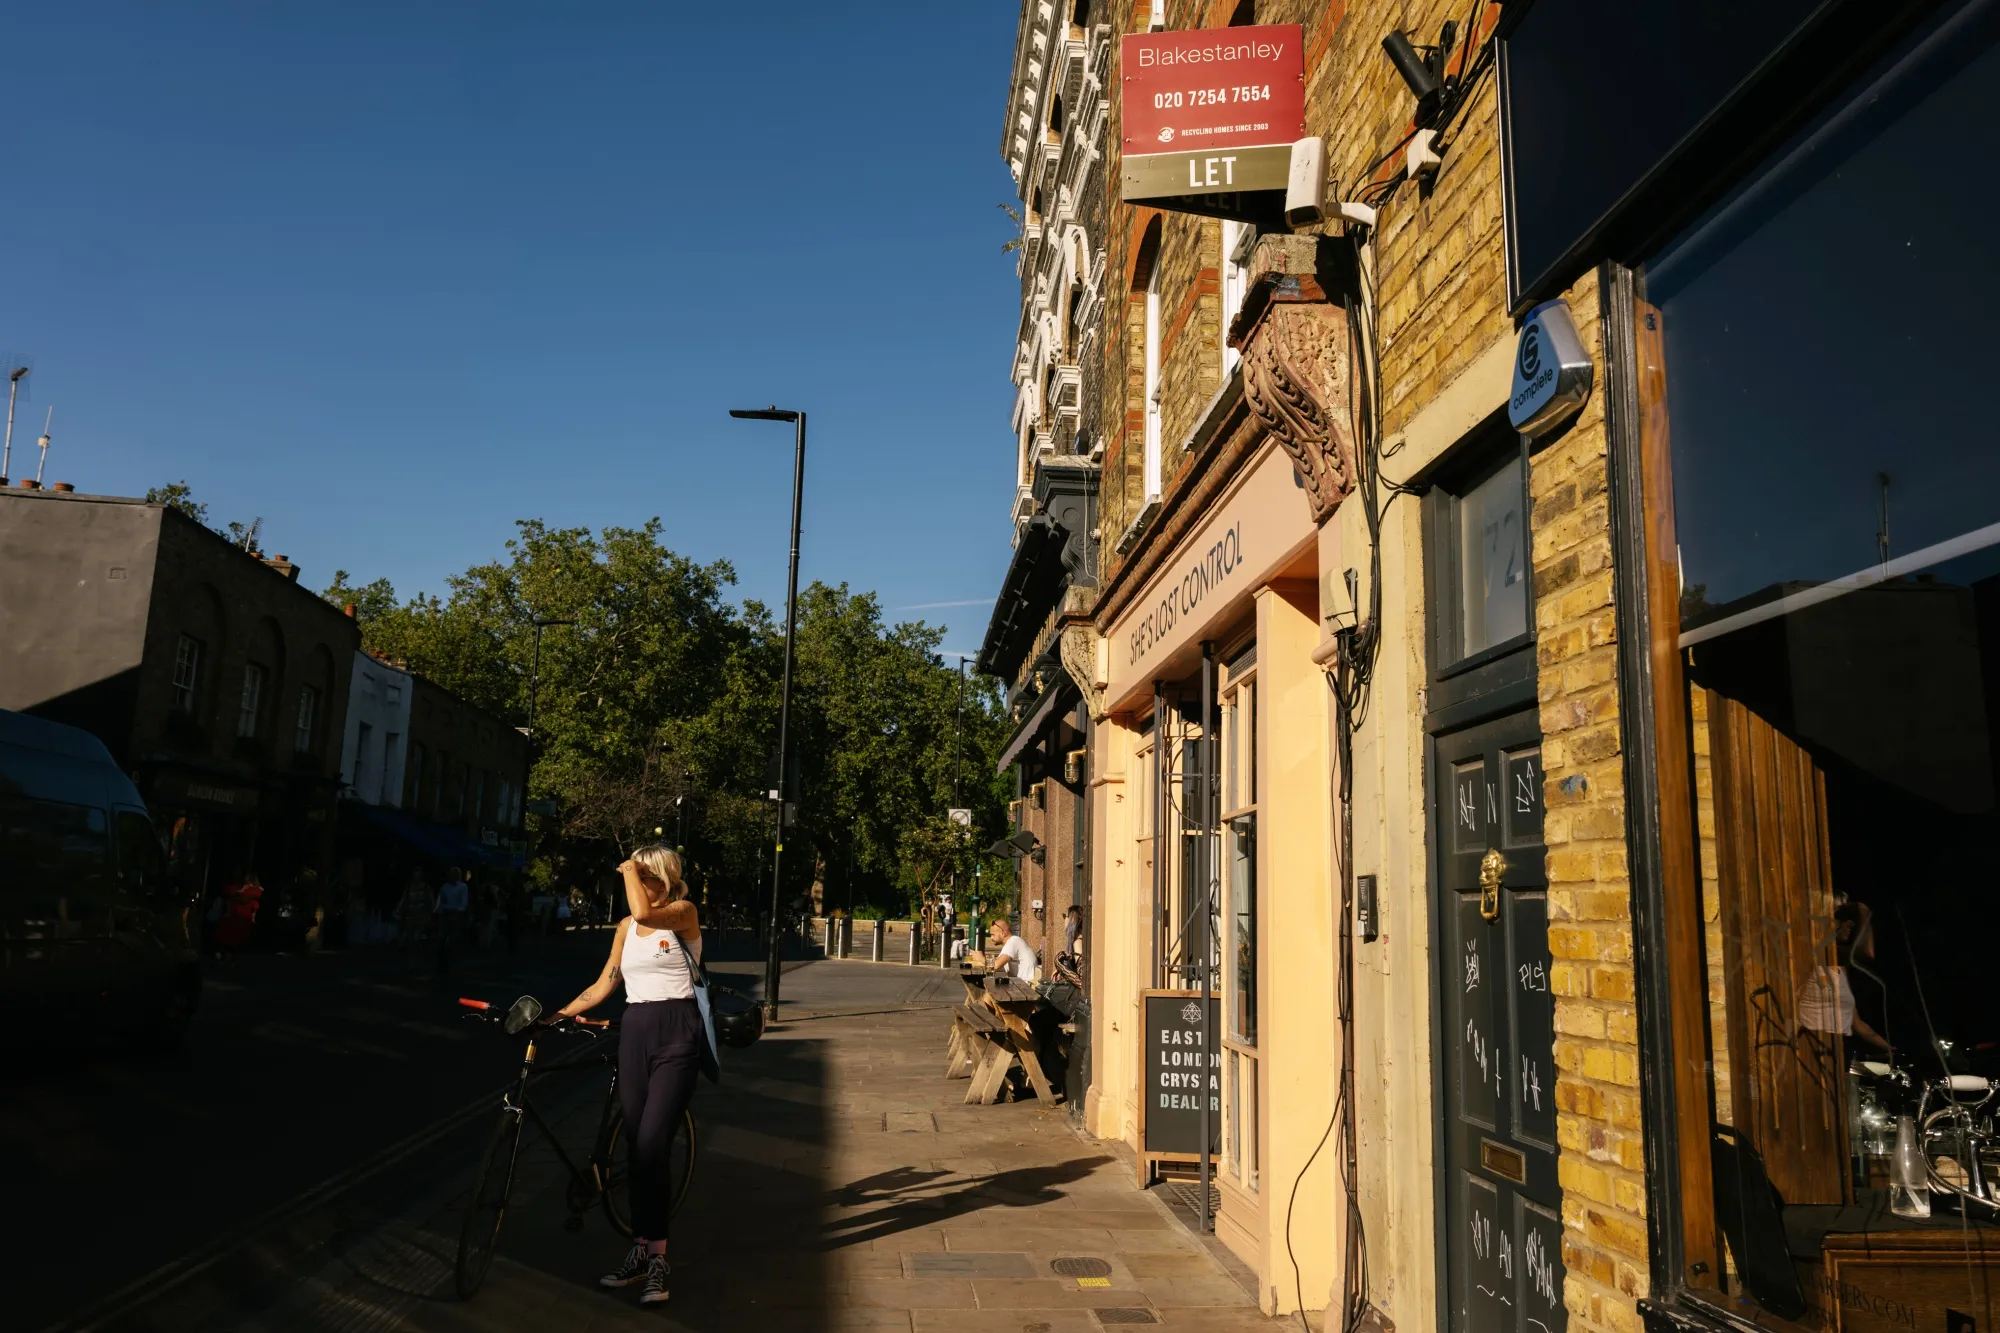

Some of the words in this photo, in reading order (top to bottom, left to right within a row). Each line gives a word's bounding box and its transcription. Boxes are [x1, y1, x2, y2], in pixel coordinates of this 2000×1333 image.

[1139, 41, 1284, 68] Blakestanley
[1154, 92, 1183, 109] 020
[1188, 88, 1227, 107] 7254
[1232, 85, 1270, 104] 7554
[1181, 127, 1213, 137] RECYCLING
[1213, 125, 1234, 134] HOMES
[1234, 124, 1252, 132] SINCE
[1253, 122, 1269, 131] 2003
[1189, 156, 1237, 188] LET
[1513, 368, 1553, 410] complete
[1130, 613, 1153, 666] SHE'S
[1155, 585, 1179, 643] LOST
[1181, 520, 1243, 616] CONTROL
[1161, 1029, 1202, 1046] EAST
[1160, 1093, 1219, 1112] DEALR
